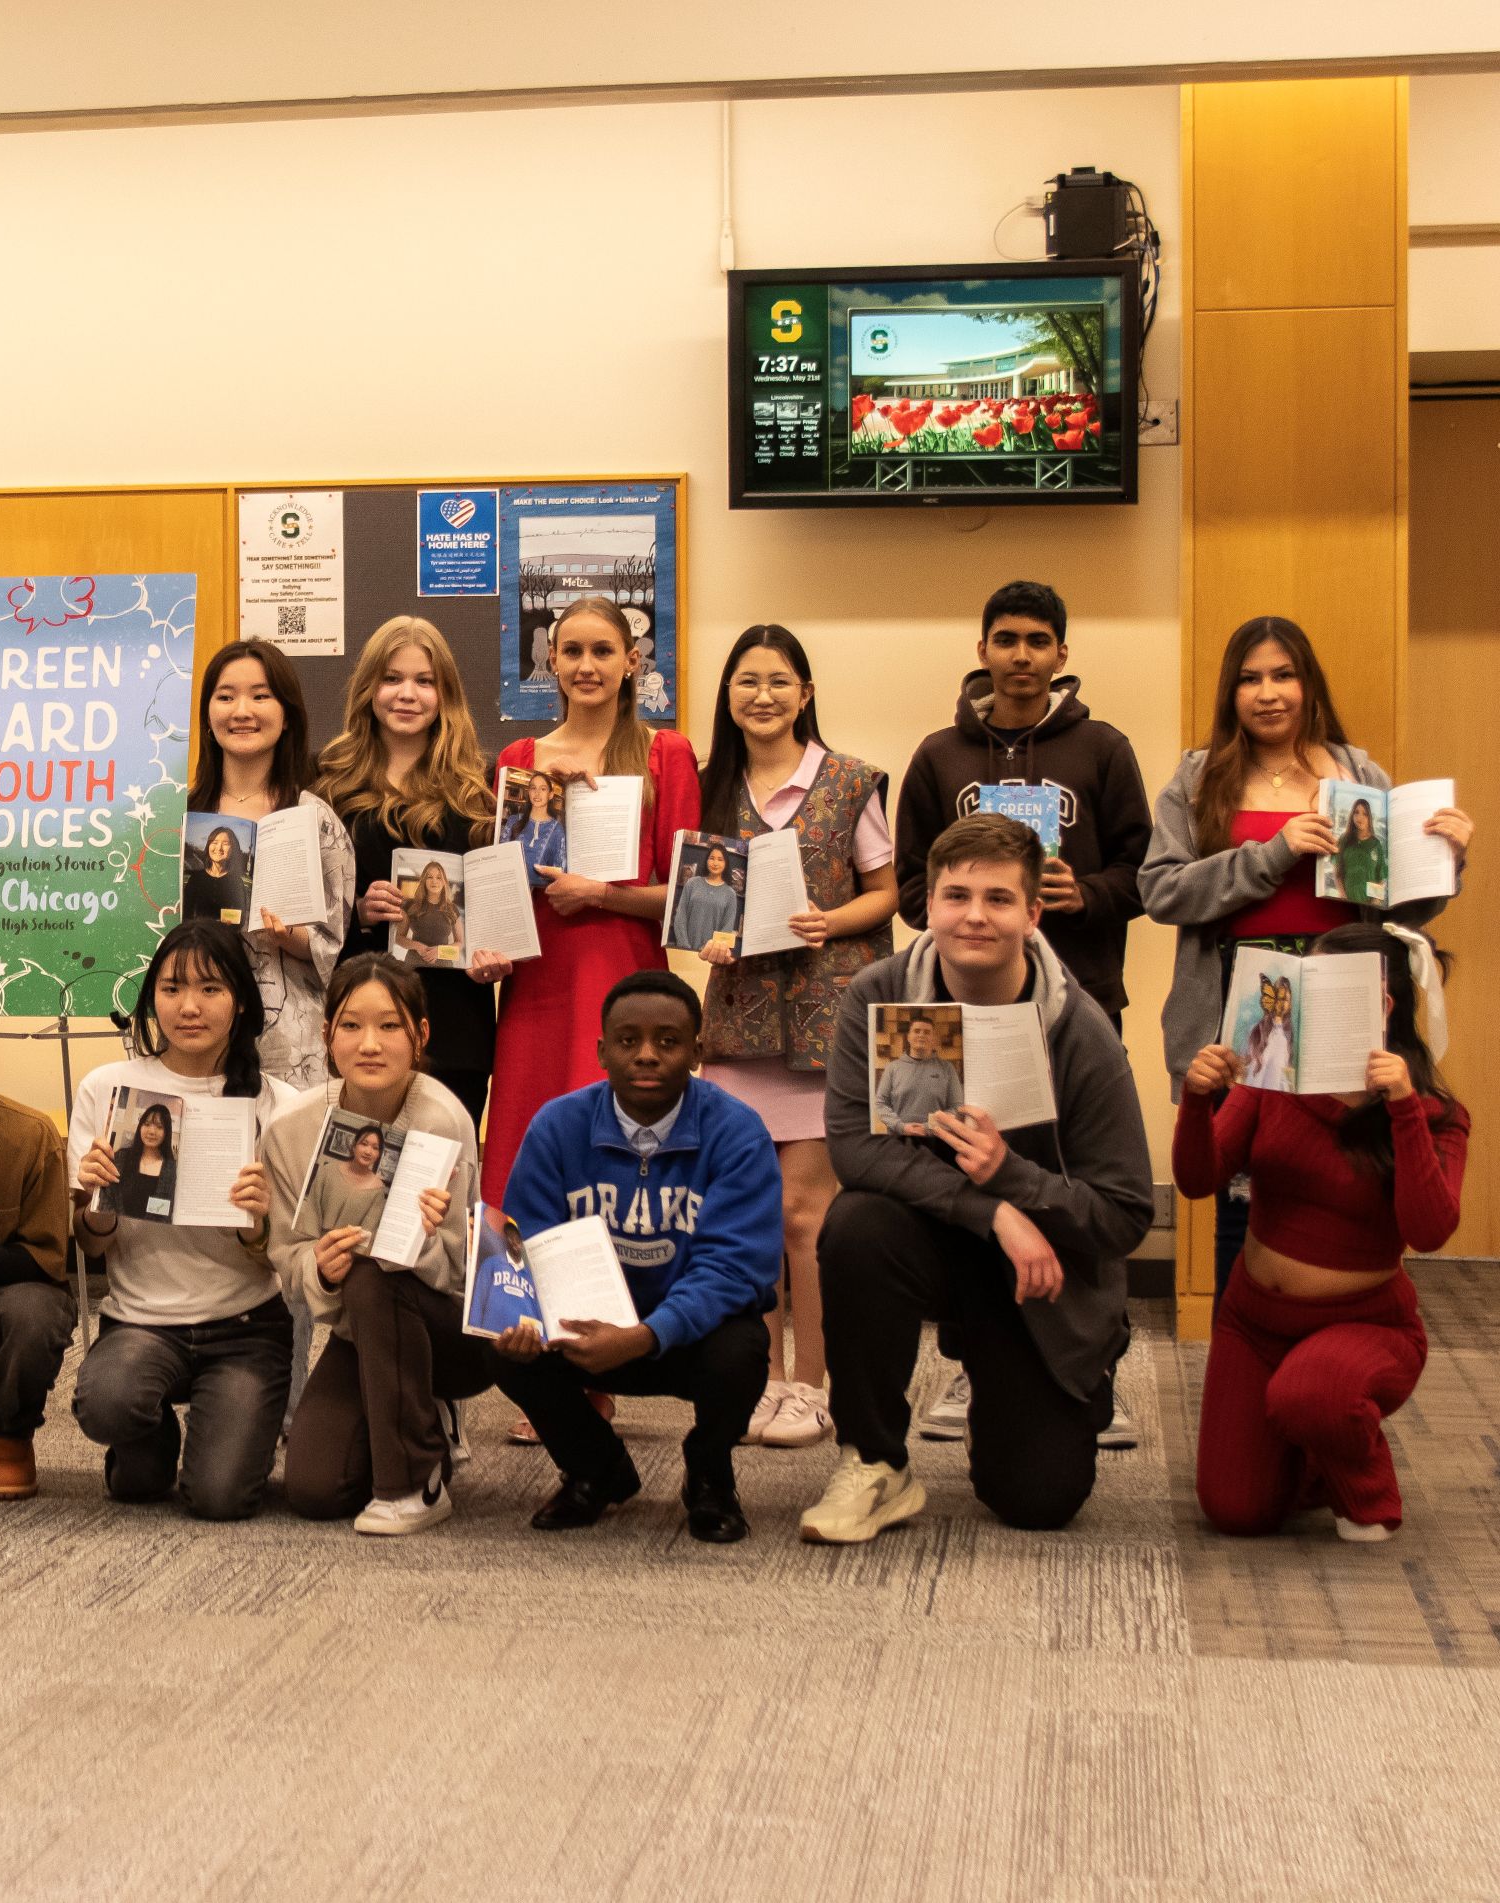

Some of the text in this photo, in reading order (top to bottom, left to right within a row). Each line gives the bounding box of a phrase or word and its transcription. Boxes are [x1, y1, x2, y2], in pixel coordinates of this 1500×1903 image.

[758, 355, 817, 373] 7:37 PM
[754, 375, 791, 383] Wednesday,
[513, 498, 533, 506] MAKE
[569, 497, 597, 505] CHOICE:
[267, 502, 314, 523] ACKNOWLEDGE
[281, 512, 300, 539] S
[268, 531, 313, 549] CARE TELL
[452, 533, 472, 541] HAS
[474, 533, 490, 541] NO
[460, 541, 488, 549] HERE.
[562, 576, 593, 588] Metra
[999, 803, 1042, 816] GREEN
[55, 855, 106, 872] Stories
[1, 878, 119, 925] Chicago
[1, 917, 75, 935] High Schools
[567, 1183, 704, 1235] DRAKE
[613, 1243, 669, 1261] NIVERSITY
[493, 1270, 535, 1299] DRAKE
